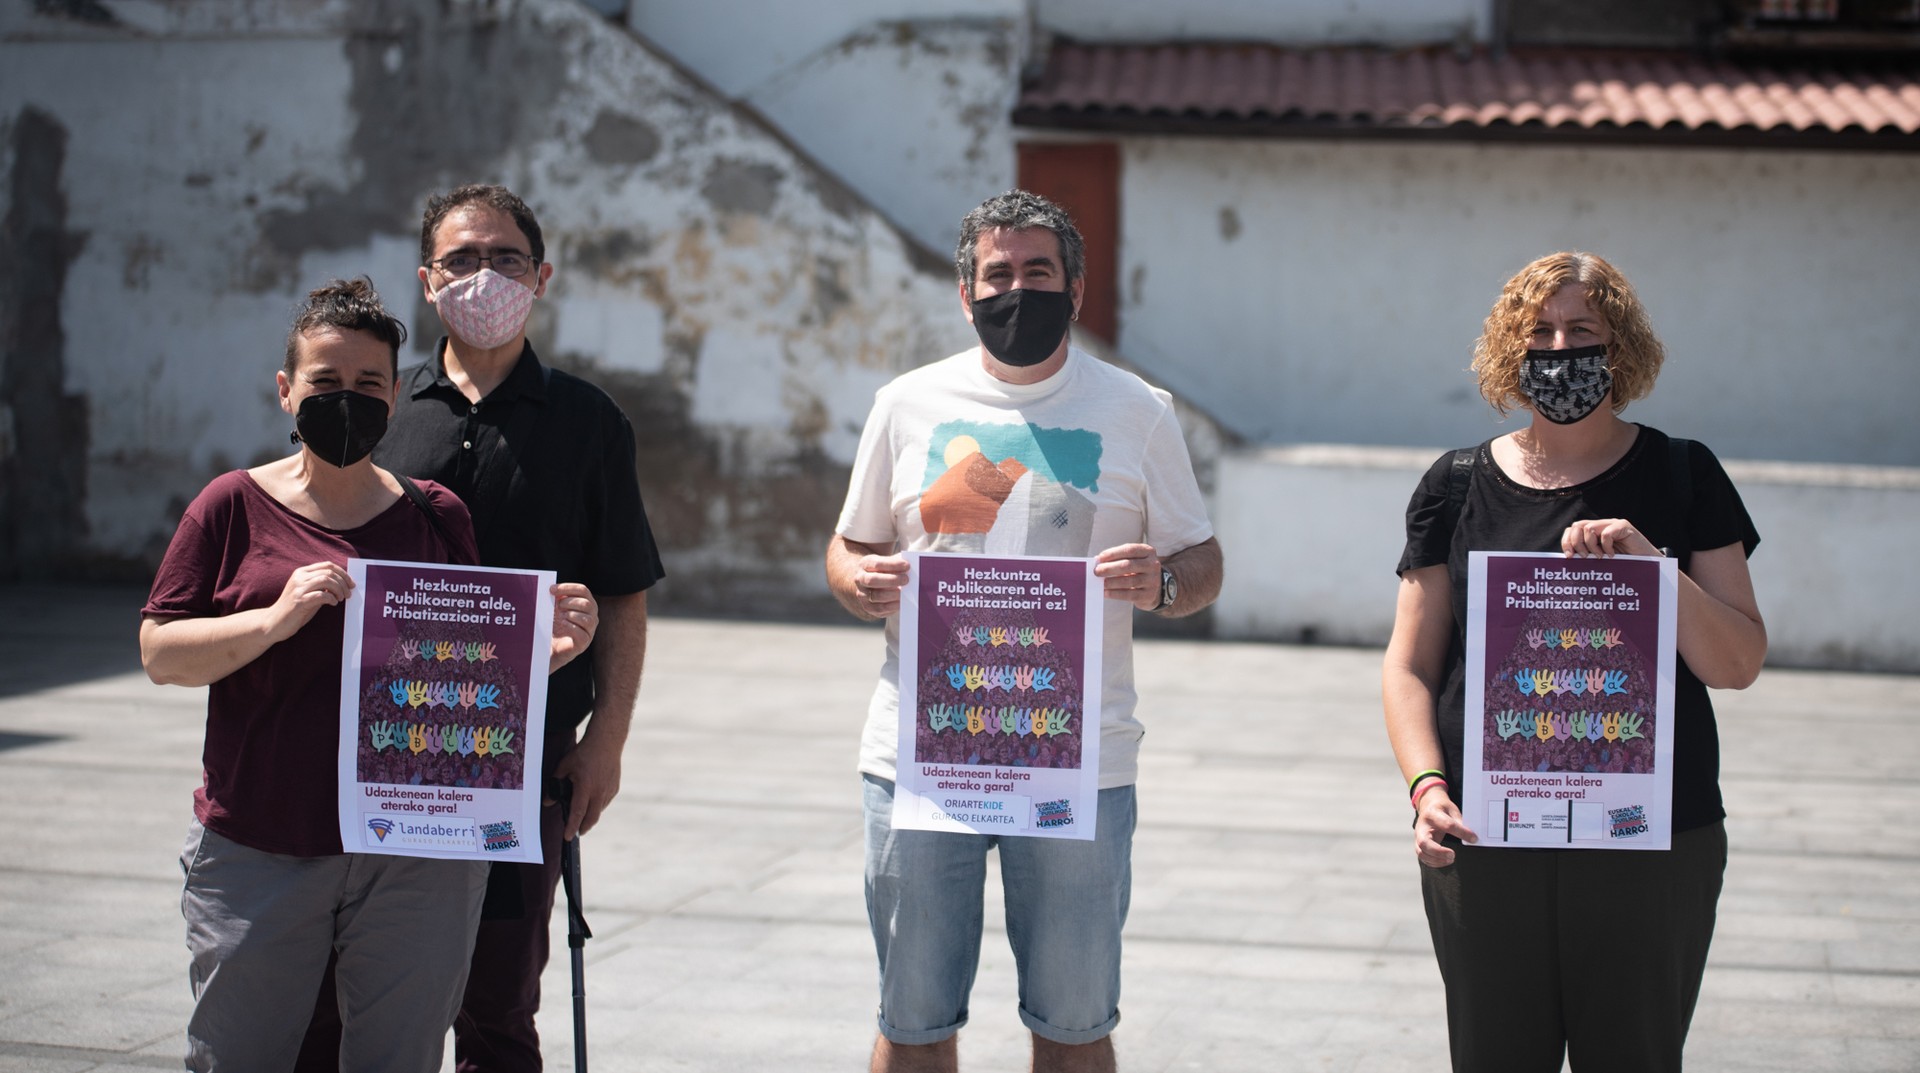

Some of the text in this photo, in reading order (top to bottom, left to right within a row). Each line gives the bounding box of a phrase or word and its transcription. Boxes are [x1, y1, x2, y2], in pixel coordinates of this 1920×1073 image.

[964, 568, 1041, 582] Hezkuntza
[1534, 568, 1613, 581] Hezkuntza
[412, 578, 491, 594] Hezkuntza
[938, 581, 1066, 596] Publikoaren alde.
[1507, 582, 1639, 596] Publikoaren alde.
[385, 591, 516, 612] Publikoaren alde.
[936, 595, 1067, 610] Pribatizazioari ez!
[1505, 596, 1640, 612] Pribatizazioari ez!
[382, 606, 516, 626] Pribatizazioari ez!
[922, 766, 1031, 781] Udazkenean kalera
[1490, 774, 1602, 787] Udazkenean kalera
[365, 786, 473, 802] Udazkenean kalera
[938, 780, 1014, 794] aterako gara!
[1506, 788, 1586, 800] aterako gara!
[381, 800, 457, 815] aterako gara!
[944, 799, 1004, 810] ORIARTEKIDE
[932, 812, 1014, 824] GURASO ELKARTEA
[1036, 817, 1074, 828] HARRO!
[399, 822, 474, 837] landaberri
[1610, 824, 1648, 838] HARRO!
[484, 840, 520, 851] HARRO!
